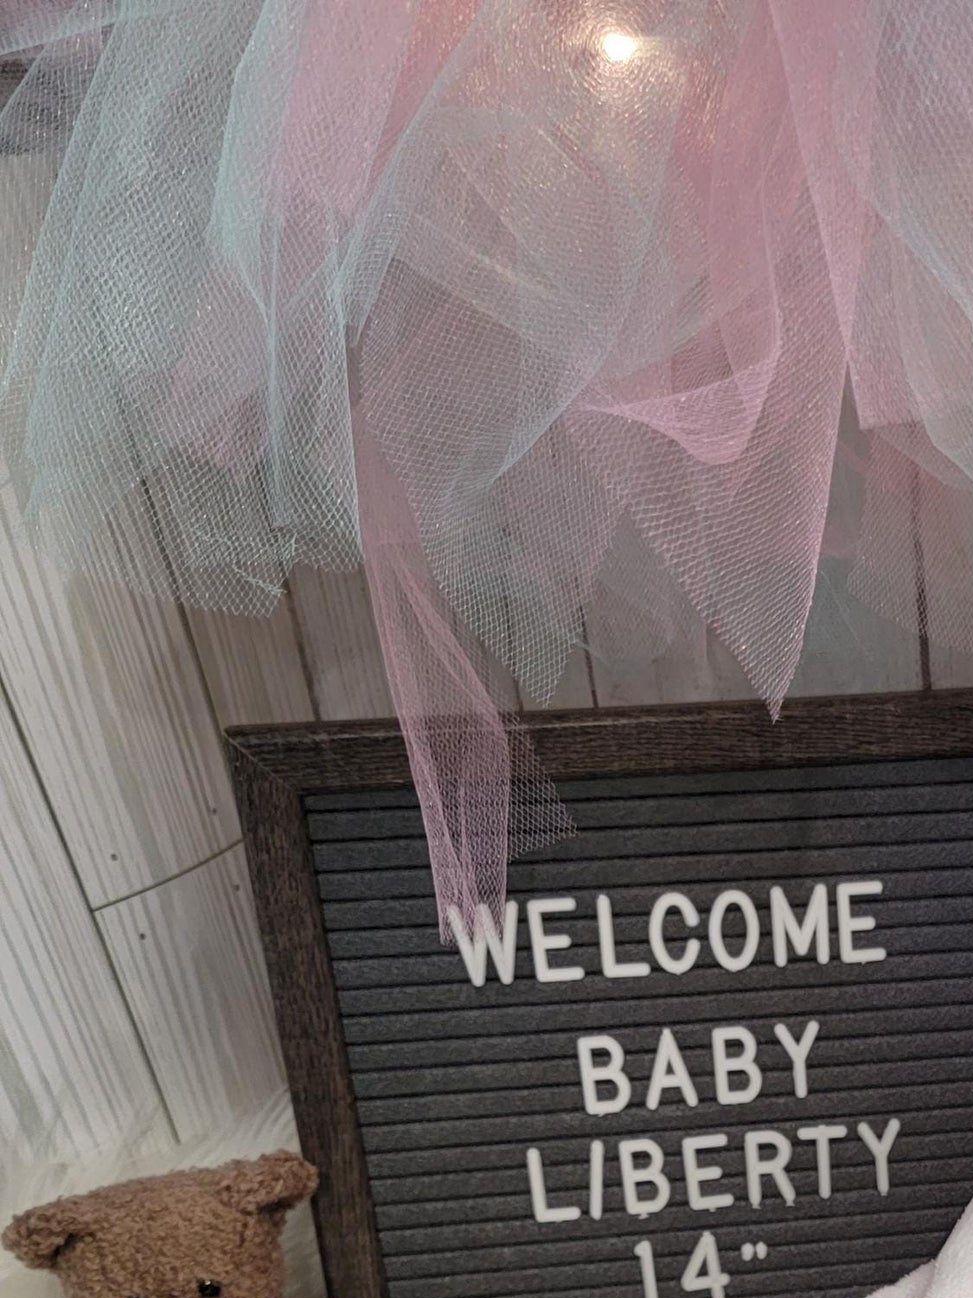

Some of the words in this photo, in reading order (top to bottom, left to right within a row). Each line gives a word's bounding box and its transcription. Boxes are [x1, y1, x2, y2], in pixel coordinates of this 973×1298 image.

[447, 880, 887, 987] WELCOME
[577, 1020, 820, 1116] BABY
[526, 1118, 900, 1223] LIBERTY
